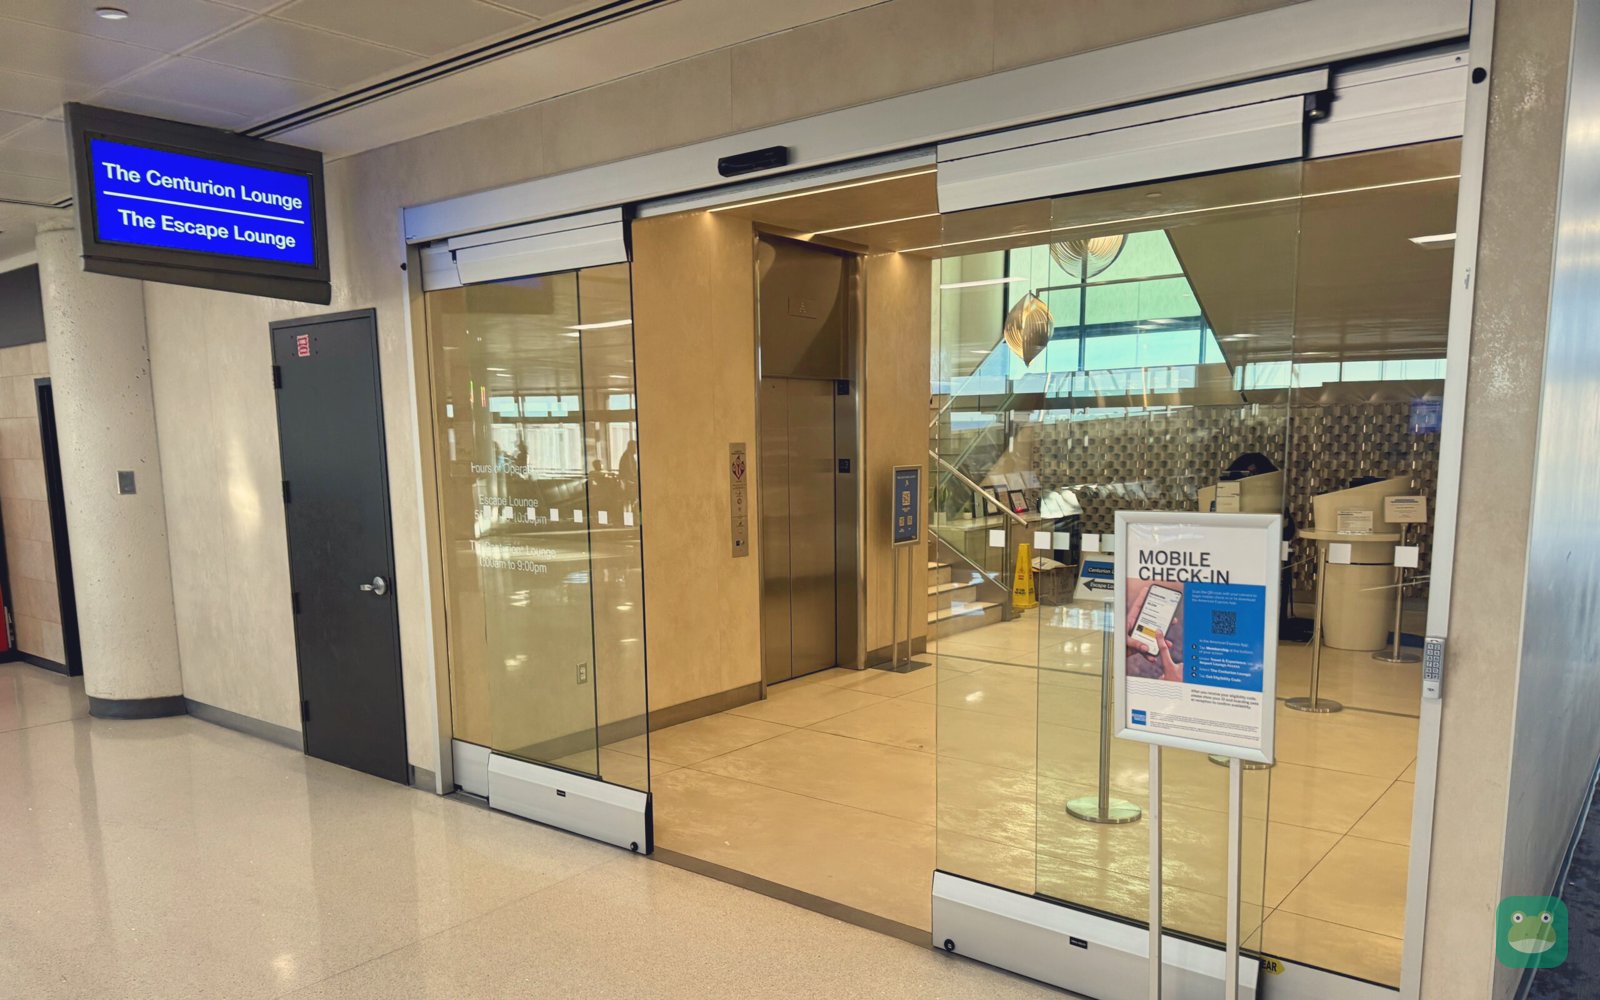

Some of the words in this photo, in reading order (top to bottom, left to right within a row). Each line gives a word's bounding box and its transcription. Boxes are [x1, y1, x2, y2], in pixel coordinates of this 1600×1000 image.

[102, 162, 140, 182] The
[146, 170, 235, 198] Centurion
[241, 185, 302, 209] Lounge
[118, 209, 155, 228] The
[161, 215, 228, 240] Escape
[234, 226, 295, 249] Lounge
[480, 495, 507, 506] Escape
[509, 496, 539, 509] Lounge
[509, 559, 516, 569] to
[517, 560, 547, 574] 9:00pm
[1139, 549, 1211, 568] MOBILE
[1138, 566, 1229, 585] CHECK-IN
